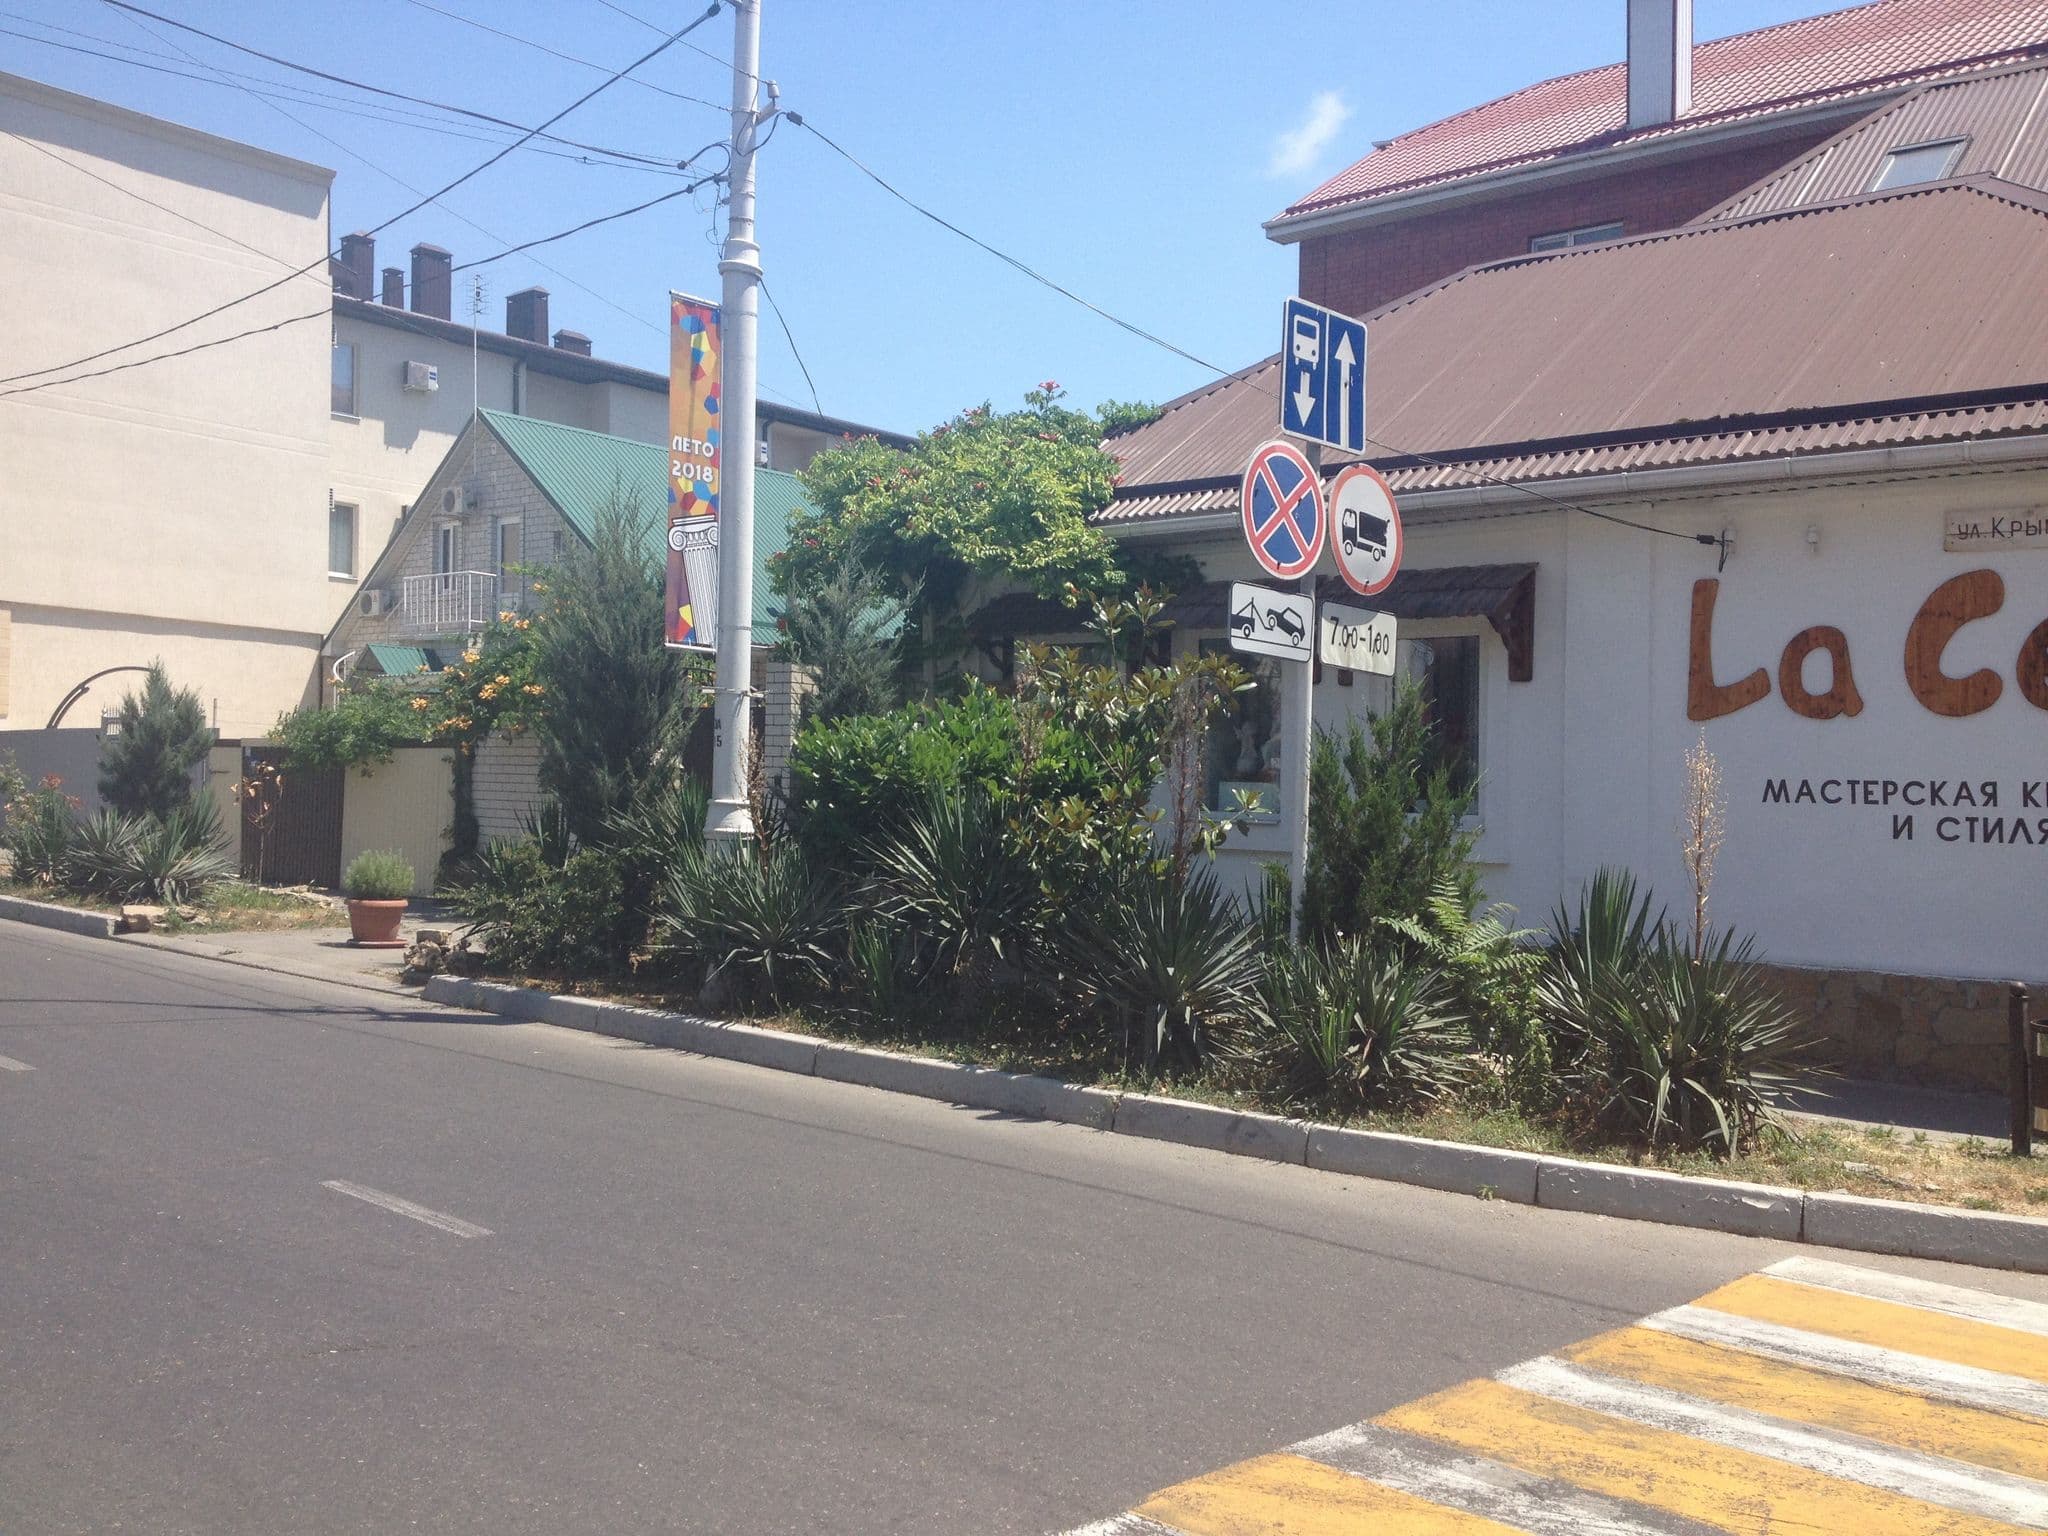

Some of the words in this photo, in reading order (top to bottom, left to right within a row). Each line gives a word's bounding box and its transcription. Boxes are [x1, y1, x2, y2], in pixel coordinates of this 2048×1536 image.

[672, 435, 714, 457] ЛЕТО
[672, 460, 713, 482] 2018
[1686, 577, 1864, 722] La
[1761, 778, 1998, 808] МАСТЕРСКАЯ
[2022, 781, 2048, 808] К
[1892, 814, 1914, 840] И
